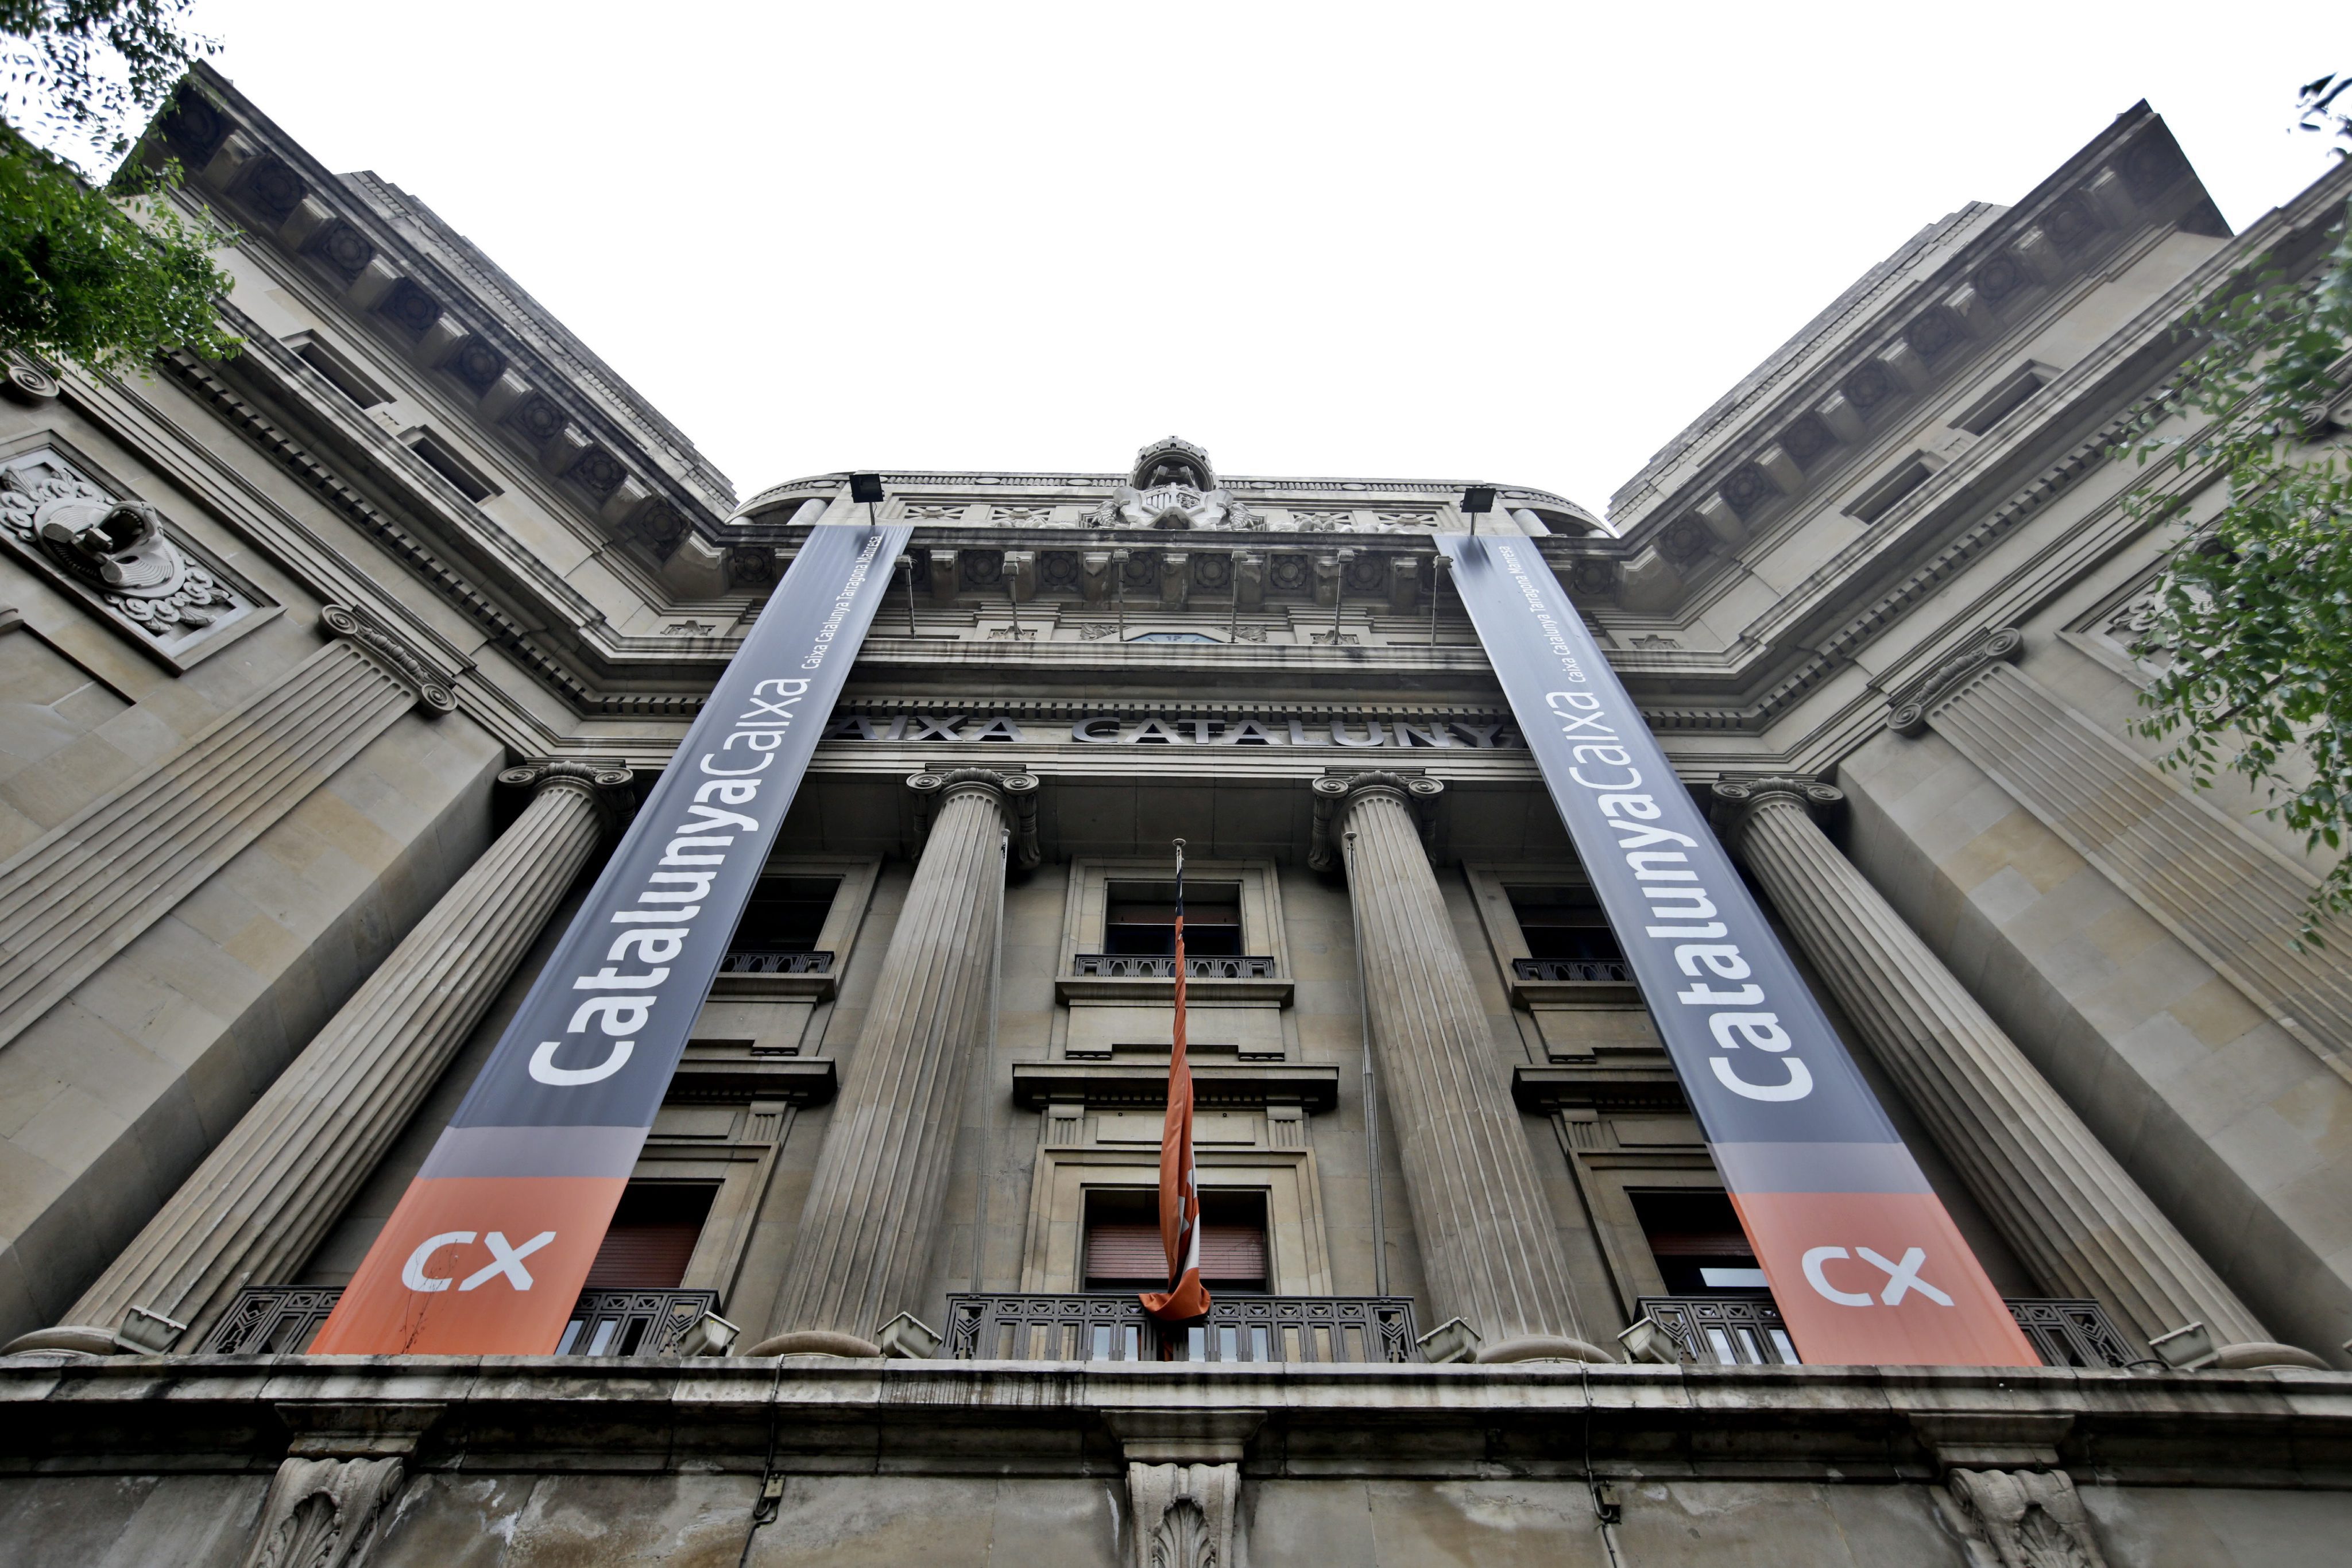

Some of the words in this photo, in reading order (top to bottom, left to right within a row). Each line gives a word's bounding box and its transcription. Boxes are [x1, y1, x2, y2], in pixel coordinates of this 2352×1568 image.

[1499, 545, 1524, 574] Manresa
[801, 644, 829, 669] Caixa
[815, 602, 850, 642] Catalunya
[836, 563, 868, 601] Tarragona
[855, 536, 883, 564] Manresa
[1515, 575, 1546, 613] Tarragona
[1537, 613, 1570, 656] Catalunya
[1561, 657, 1586, 683] Caixa
[820, 715, 1027, 742] AIXA
[528, 678, 811, 1086] CatalunyaCaixa
[1545, 691, 1813, 1102] CatalunyaCaixa
